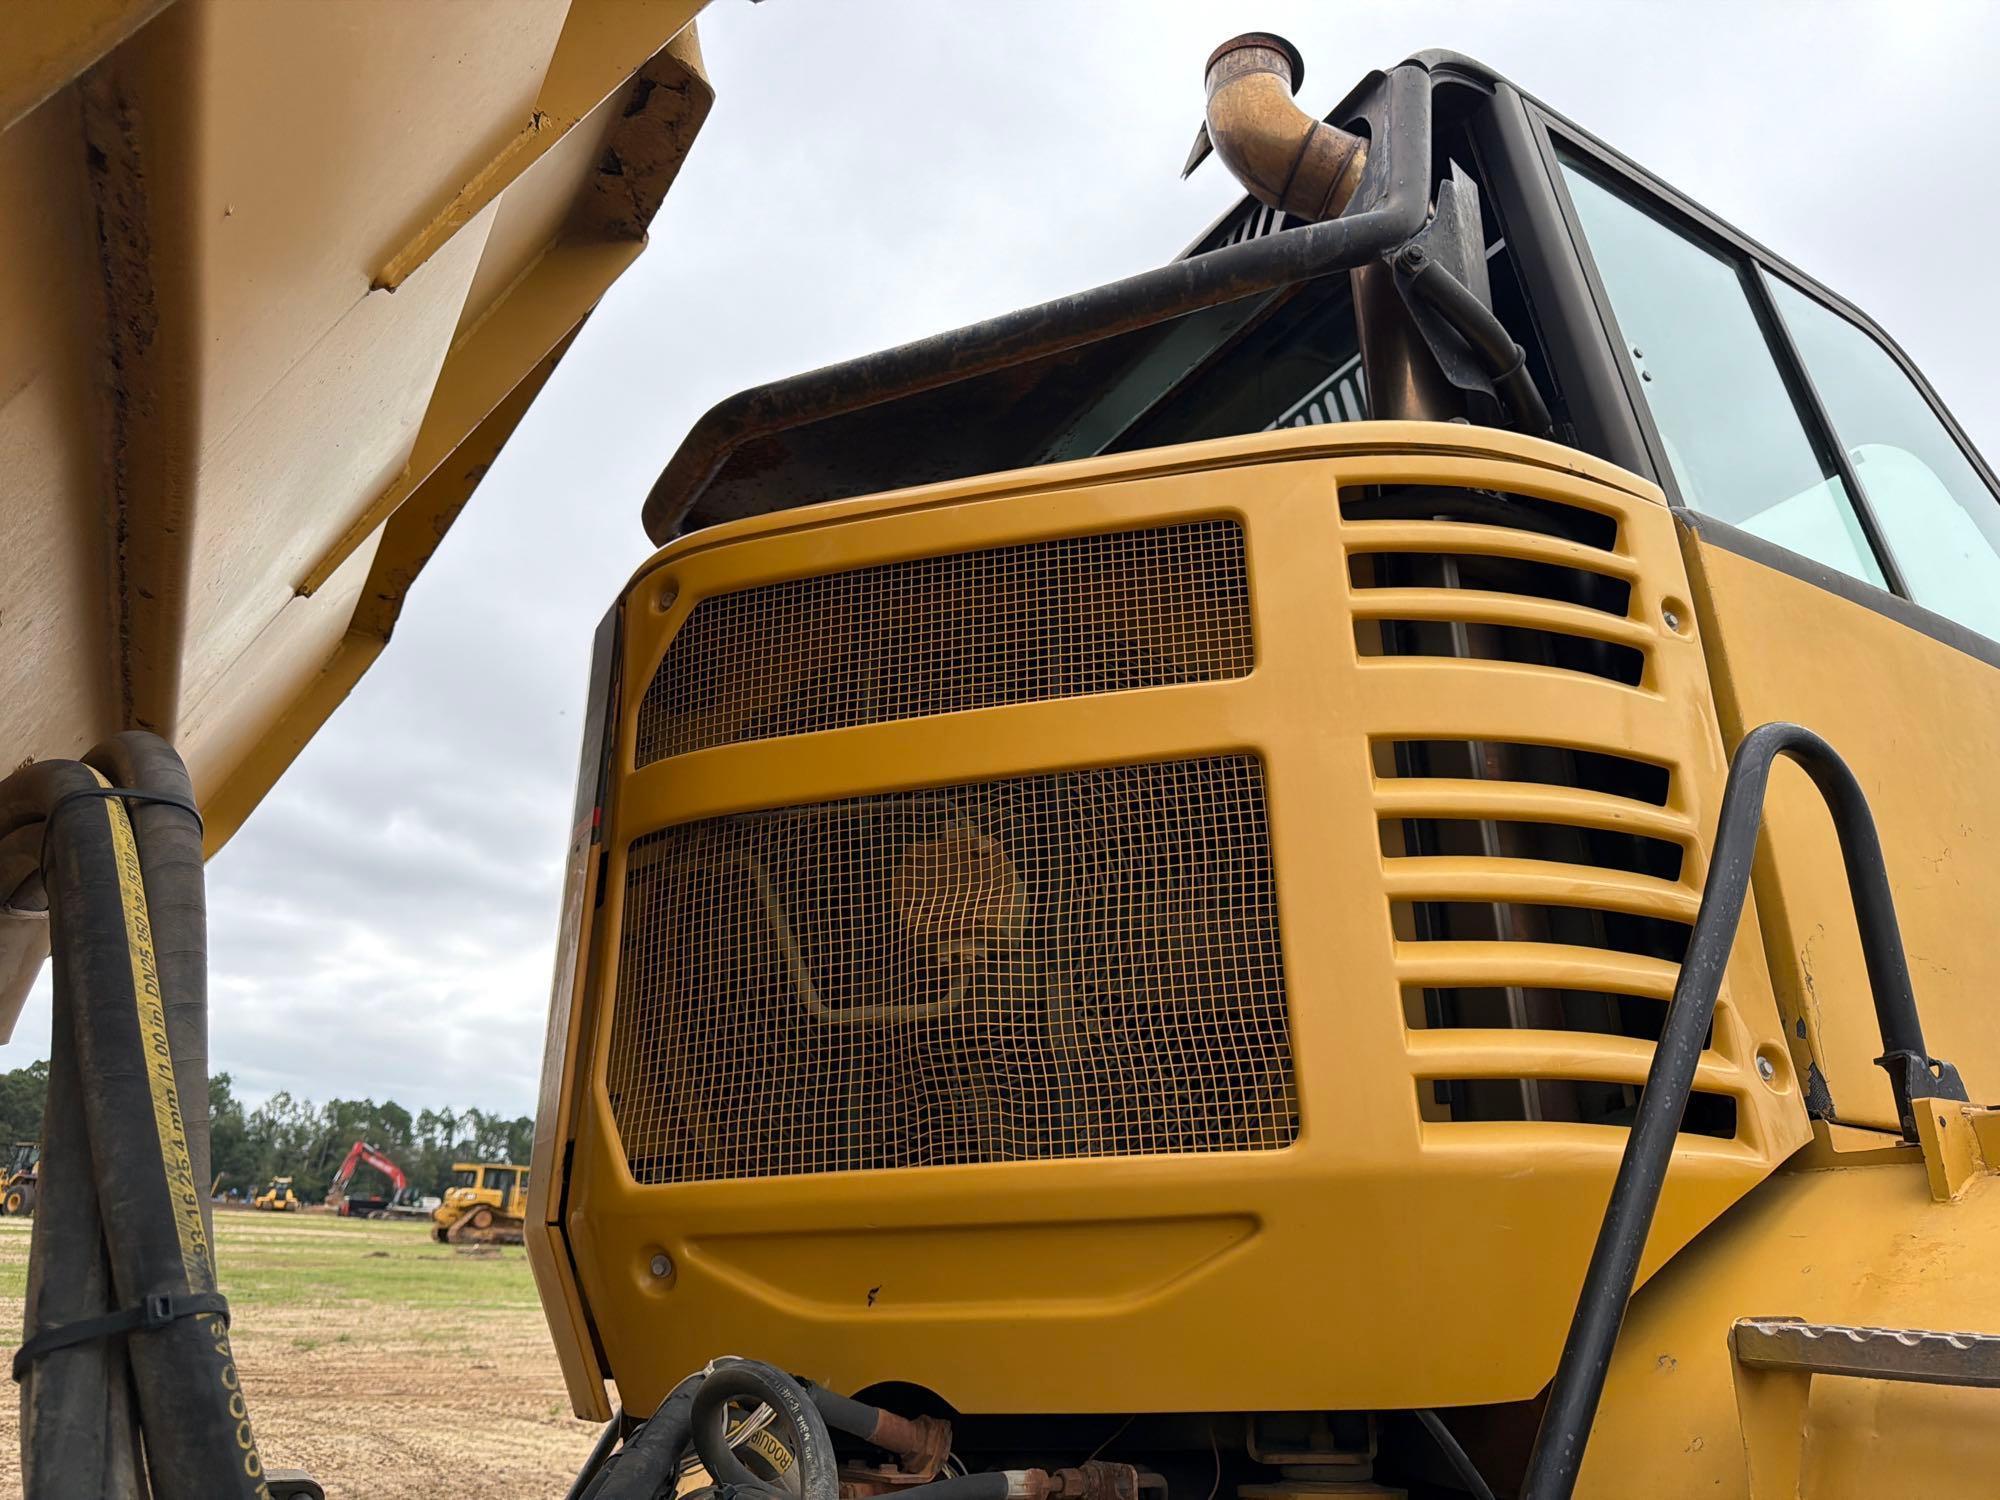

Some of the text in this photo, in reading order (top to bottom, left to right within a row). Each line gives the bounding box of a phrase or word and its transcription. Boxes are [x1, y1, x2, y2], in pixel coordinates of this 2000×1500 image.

[132, 889, 147, 915] bar
[134, 916, 151, 947] 350
[139, 947, 159, 999] DN25
[166, 1088, 182, 1132] mm
[174, 1139, 192, 1186] 25.4
